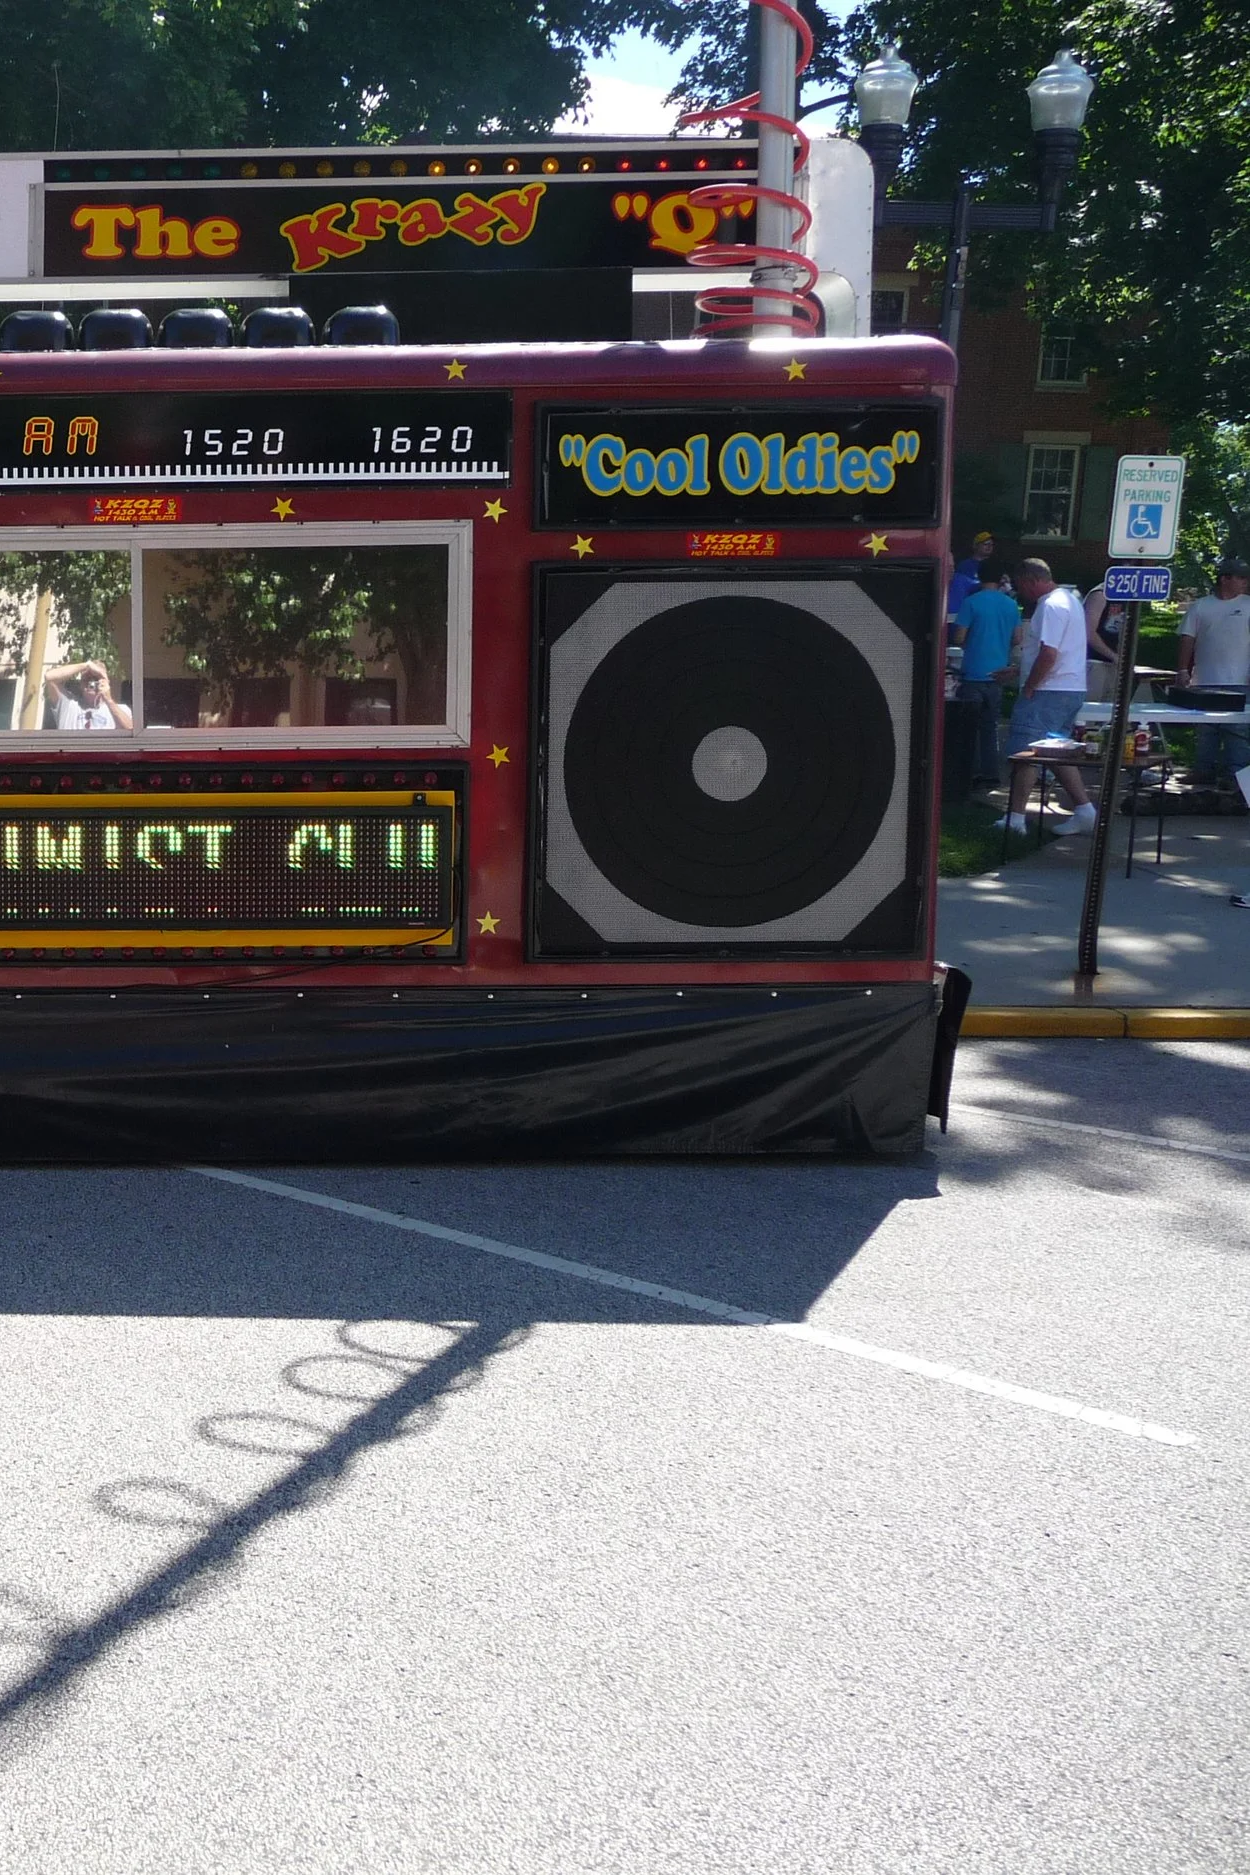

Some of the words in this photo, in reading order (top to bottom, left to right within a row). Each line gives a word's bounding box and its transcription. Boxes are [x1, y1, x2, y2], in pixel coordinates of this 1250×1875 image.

[73, 203, 242, 260] The
[280, 181, 547, 274] Krazy
[22, 415, 100, 456] AM
[182, 428, 285, 455] 1520
[371, 426, 474, 454] 1620
[559, 431, 711, 497] "Cool
[718, 430, 920, 495] Oldies"
[1122, 468, 1178, 484] RESERVED
[104, 498, 164, 509] KZQZ
[1123, 488, 1171, 503] PARKING
[702, 533, 763, 544] KZQZ
[1107, 573, 1138, 594] $250
[1141, 574, 1168, 594] FINE
